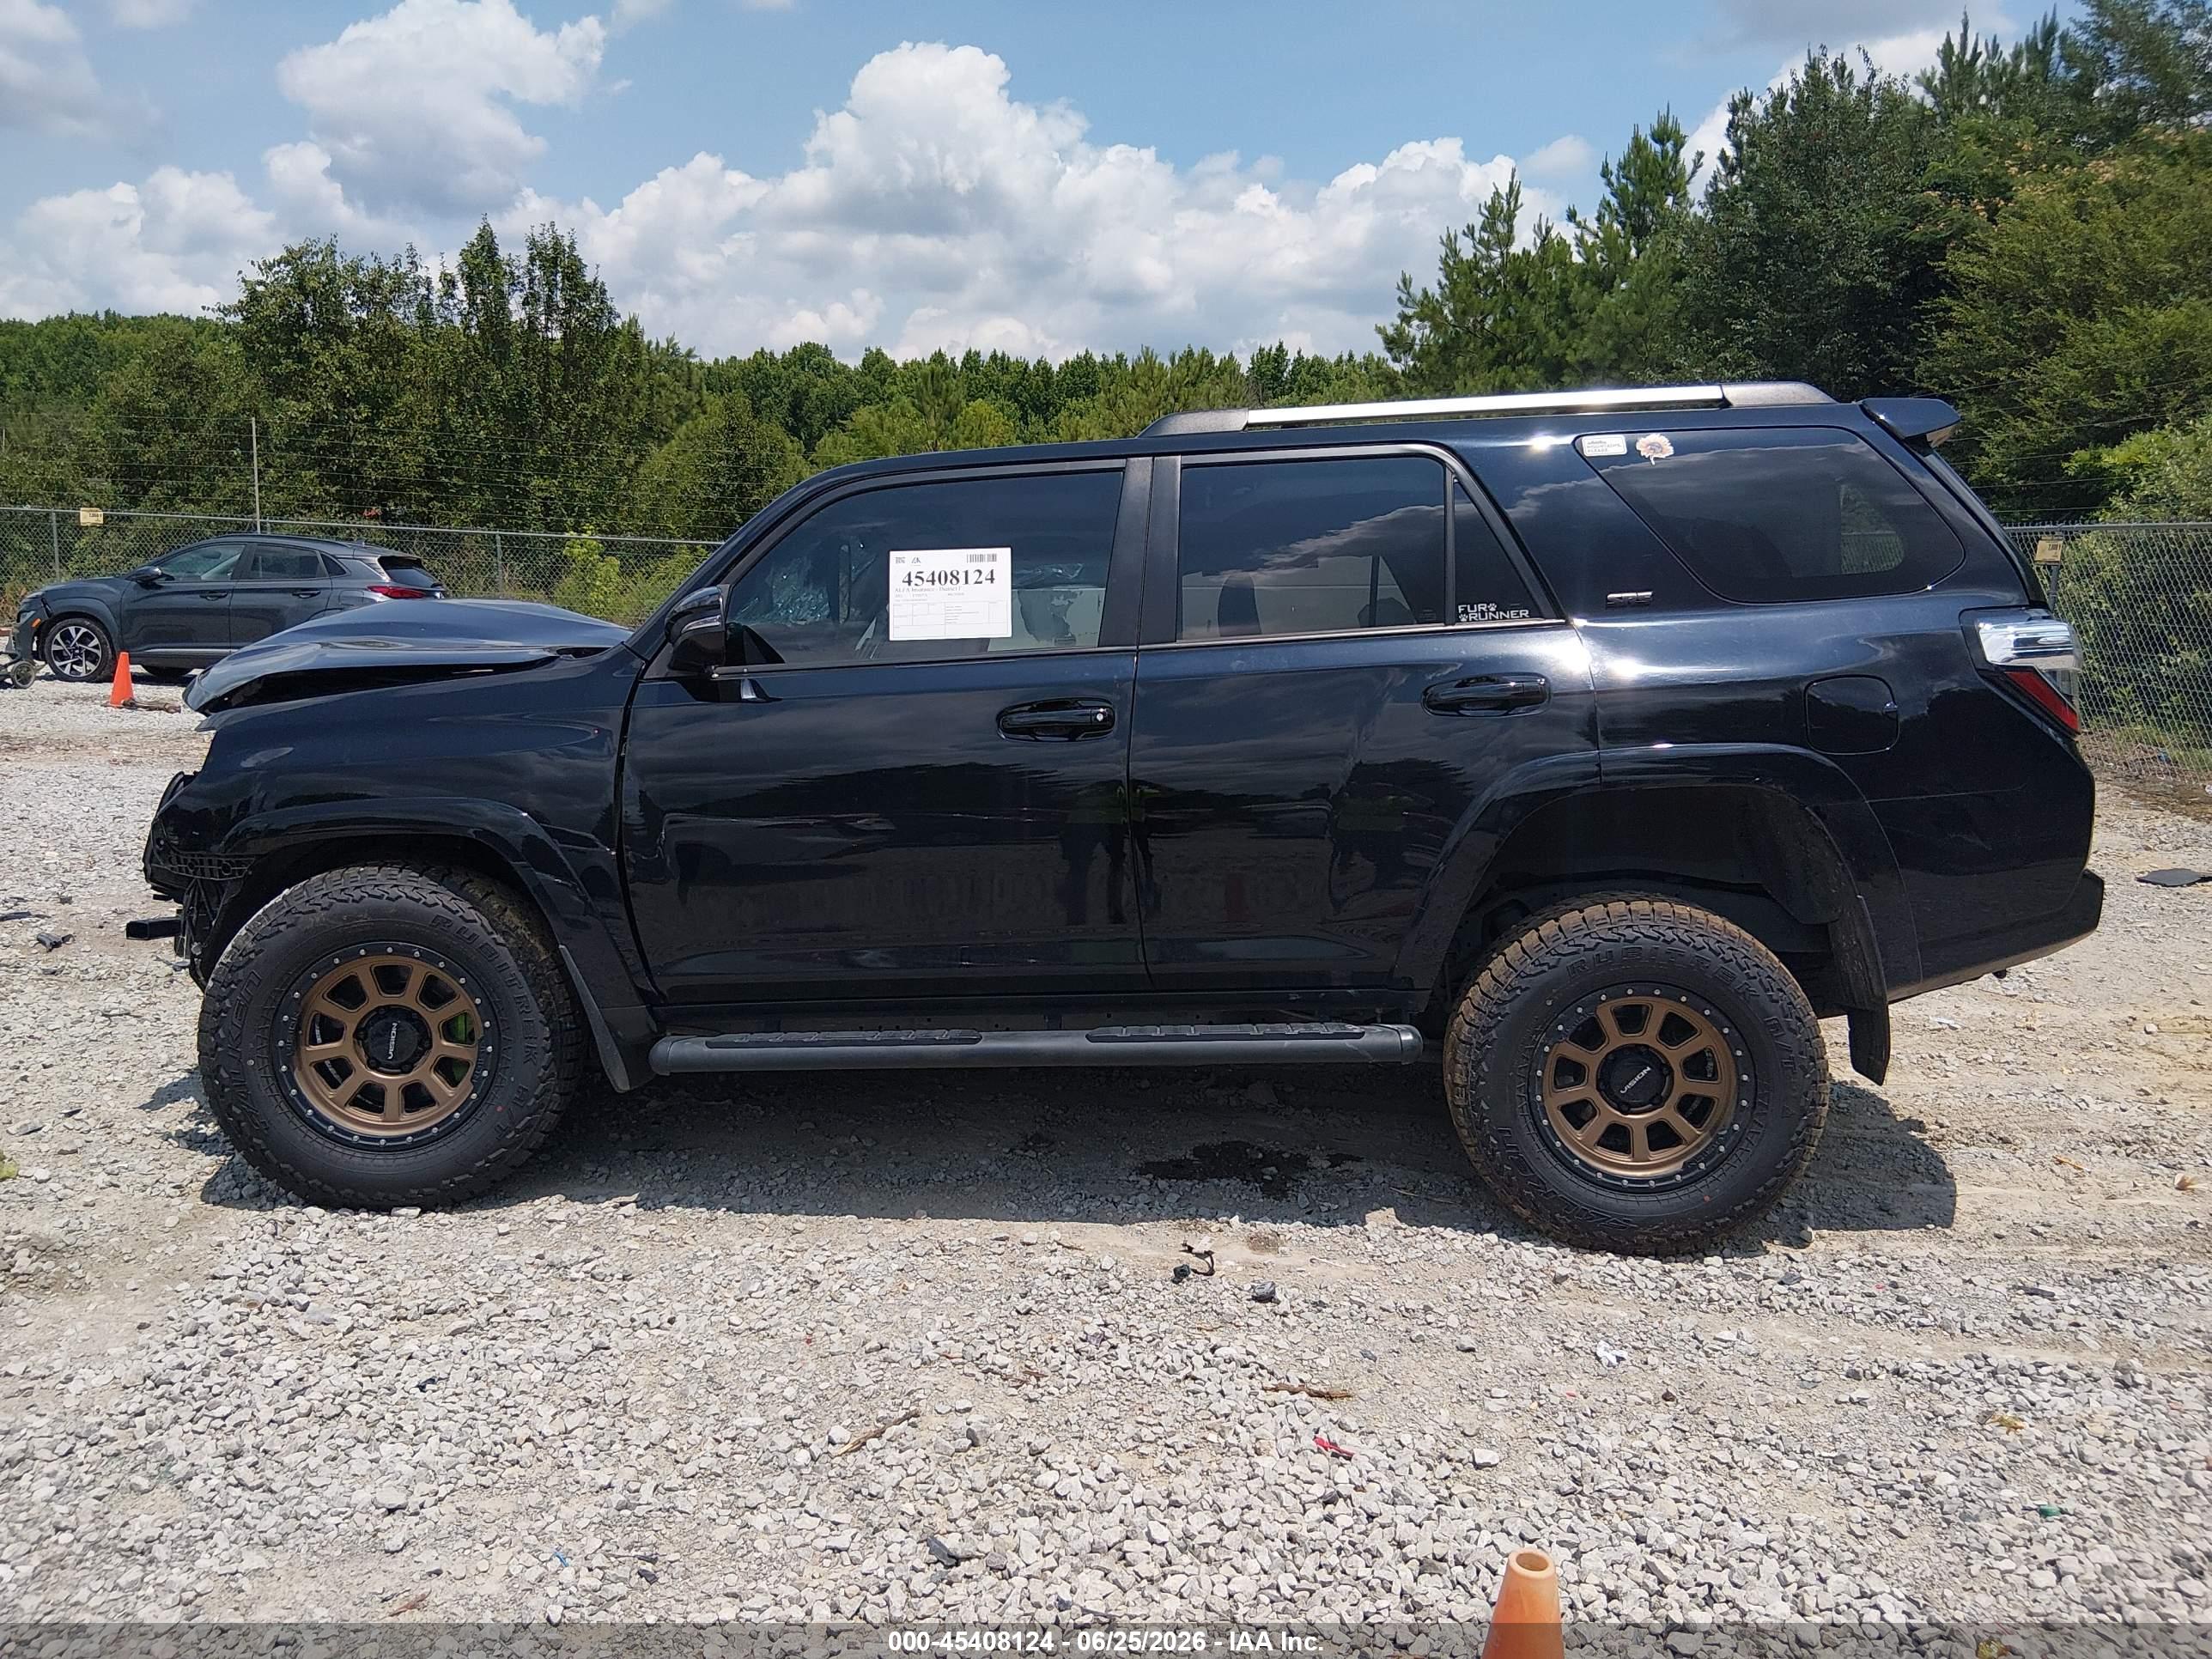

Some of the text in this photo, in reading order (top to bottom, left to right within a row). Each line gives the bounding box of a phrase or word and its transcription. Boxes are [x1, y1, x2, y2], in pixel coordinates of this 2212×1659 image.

[902, 568, 995, 586] 45408124
[1458, 604, 1488, 614] FUR
[1468, 609, 1530, 622] RUNNER
[1565, 945, 1758, 996] RUBITREK
[430, 914, 538, 1065] RUBITREK
[386, 1021, 398, 1060] VISION
[1620, 1066, 1652, 1094] VISION
